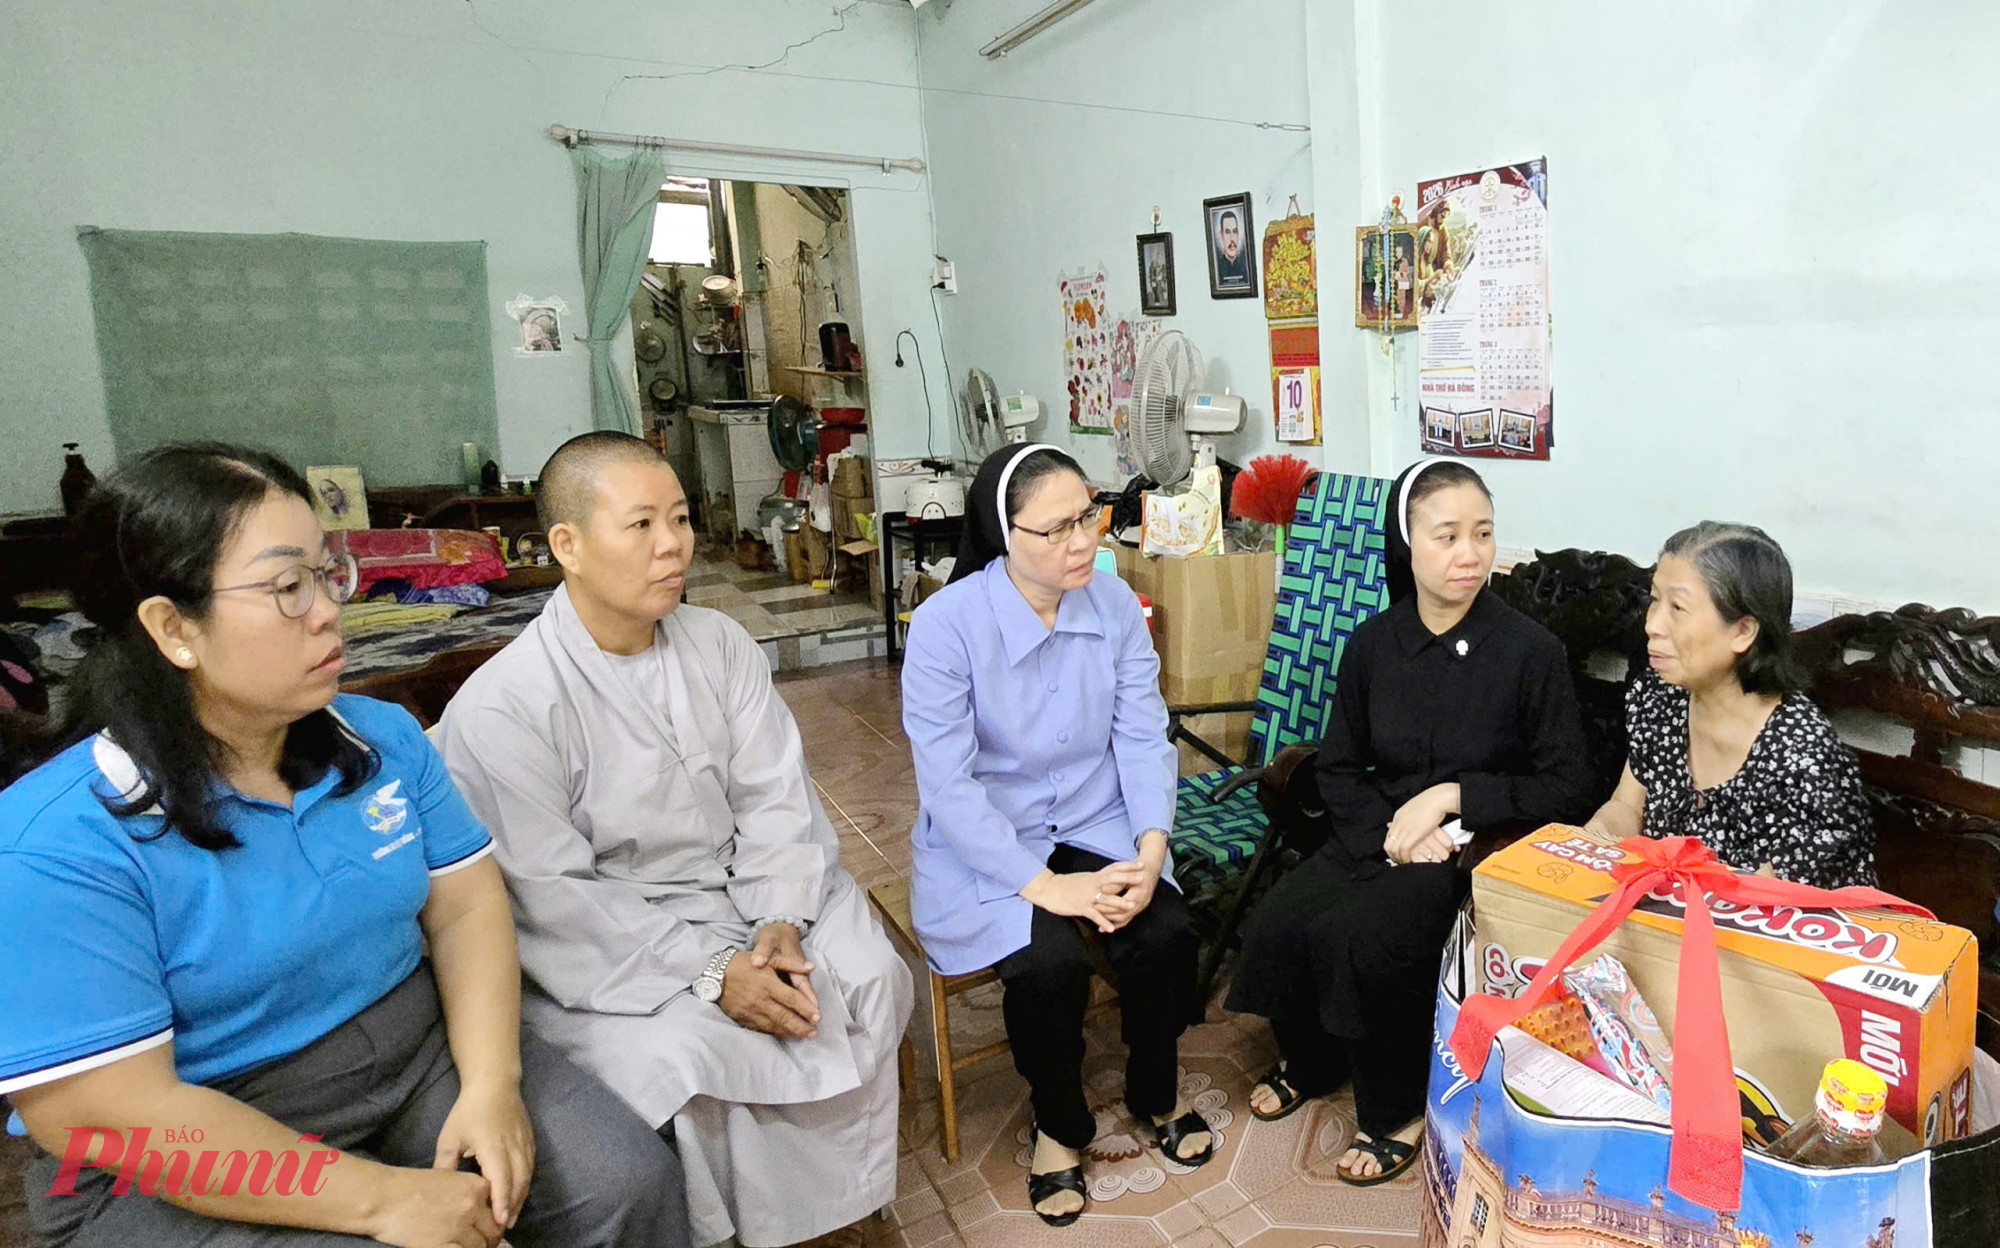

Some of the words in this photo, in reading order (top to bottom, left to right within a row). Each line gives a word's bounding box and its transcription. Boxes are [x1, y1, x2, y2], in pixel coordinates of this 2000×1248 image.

[1423, 181, 1444, 204] 2026
[1287, 380, 1303, 409] 10
[1535, 840, 1575, 857] CAY
[1596, 846, 1622, 858] SA
[1574, 853, 1612, 871] ÔM
[1862, 968, 1919, 997] MỚI
[1860, 1009, 1908, 1087] MỚI
